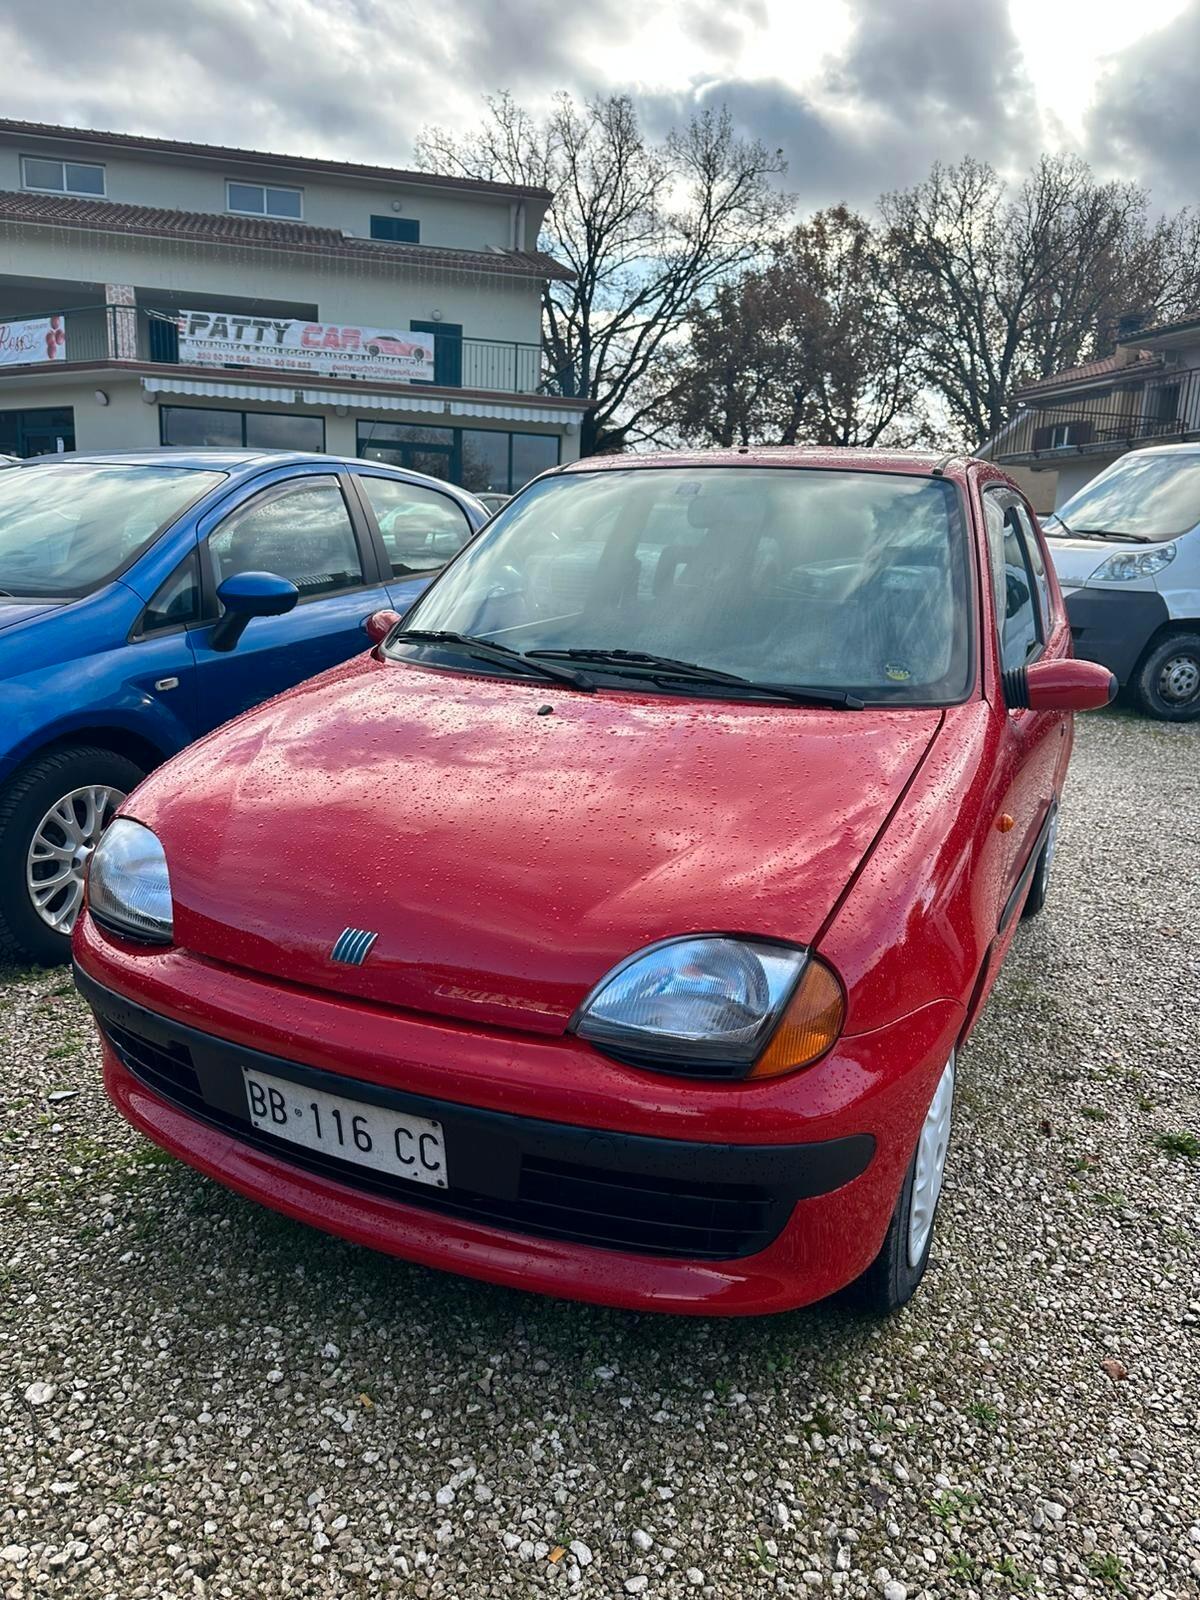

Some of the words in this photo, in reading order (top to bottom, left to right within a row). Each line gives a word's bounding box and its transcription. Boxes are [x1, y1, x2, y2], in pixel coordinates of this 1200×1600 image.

[186, 340, 246, 352] RIVENDITA
[260, 346, 316, 358] NOLEGGIO
[320, 351, 349, 361] AUTO
[189, 313, 292, 344] PATTY
[301, 325, 361, 352] CAR
[248, 1080, 288, 1125] BB
[310, 1103, 373, 1152] 116
[394, 1128, 440, 1170] CC
